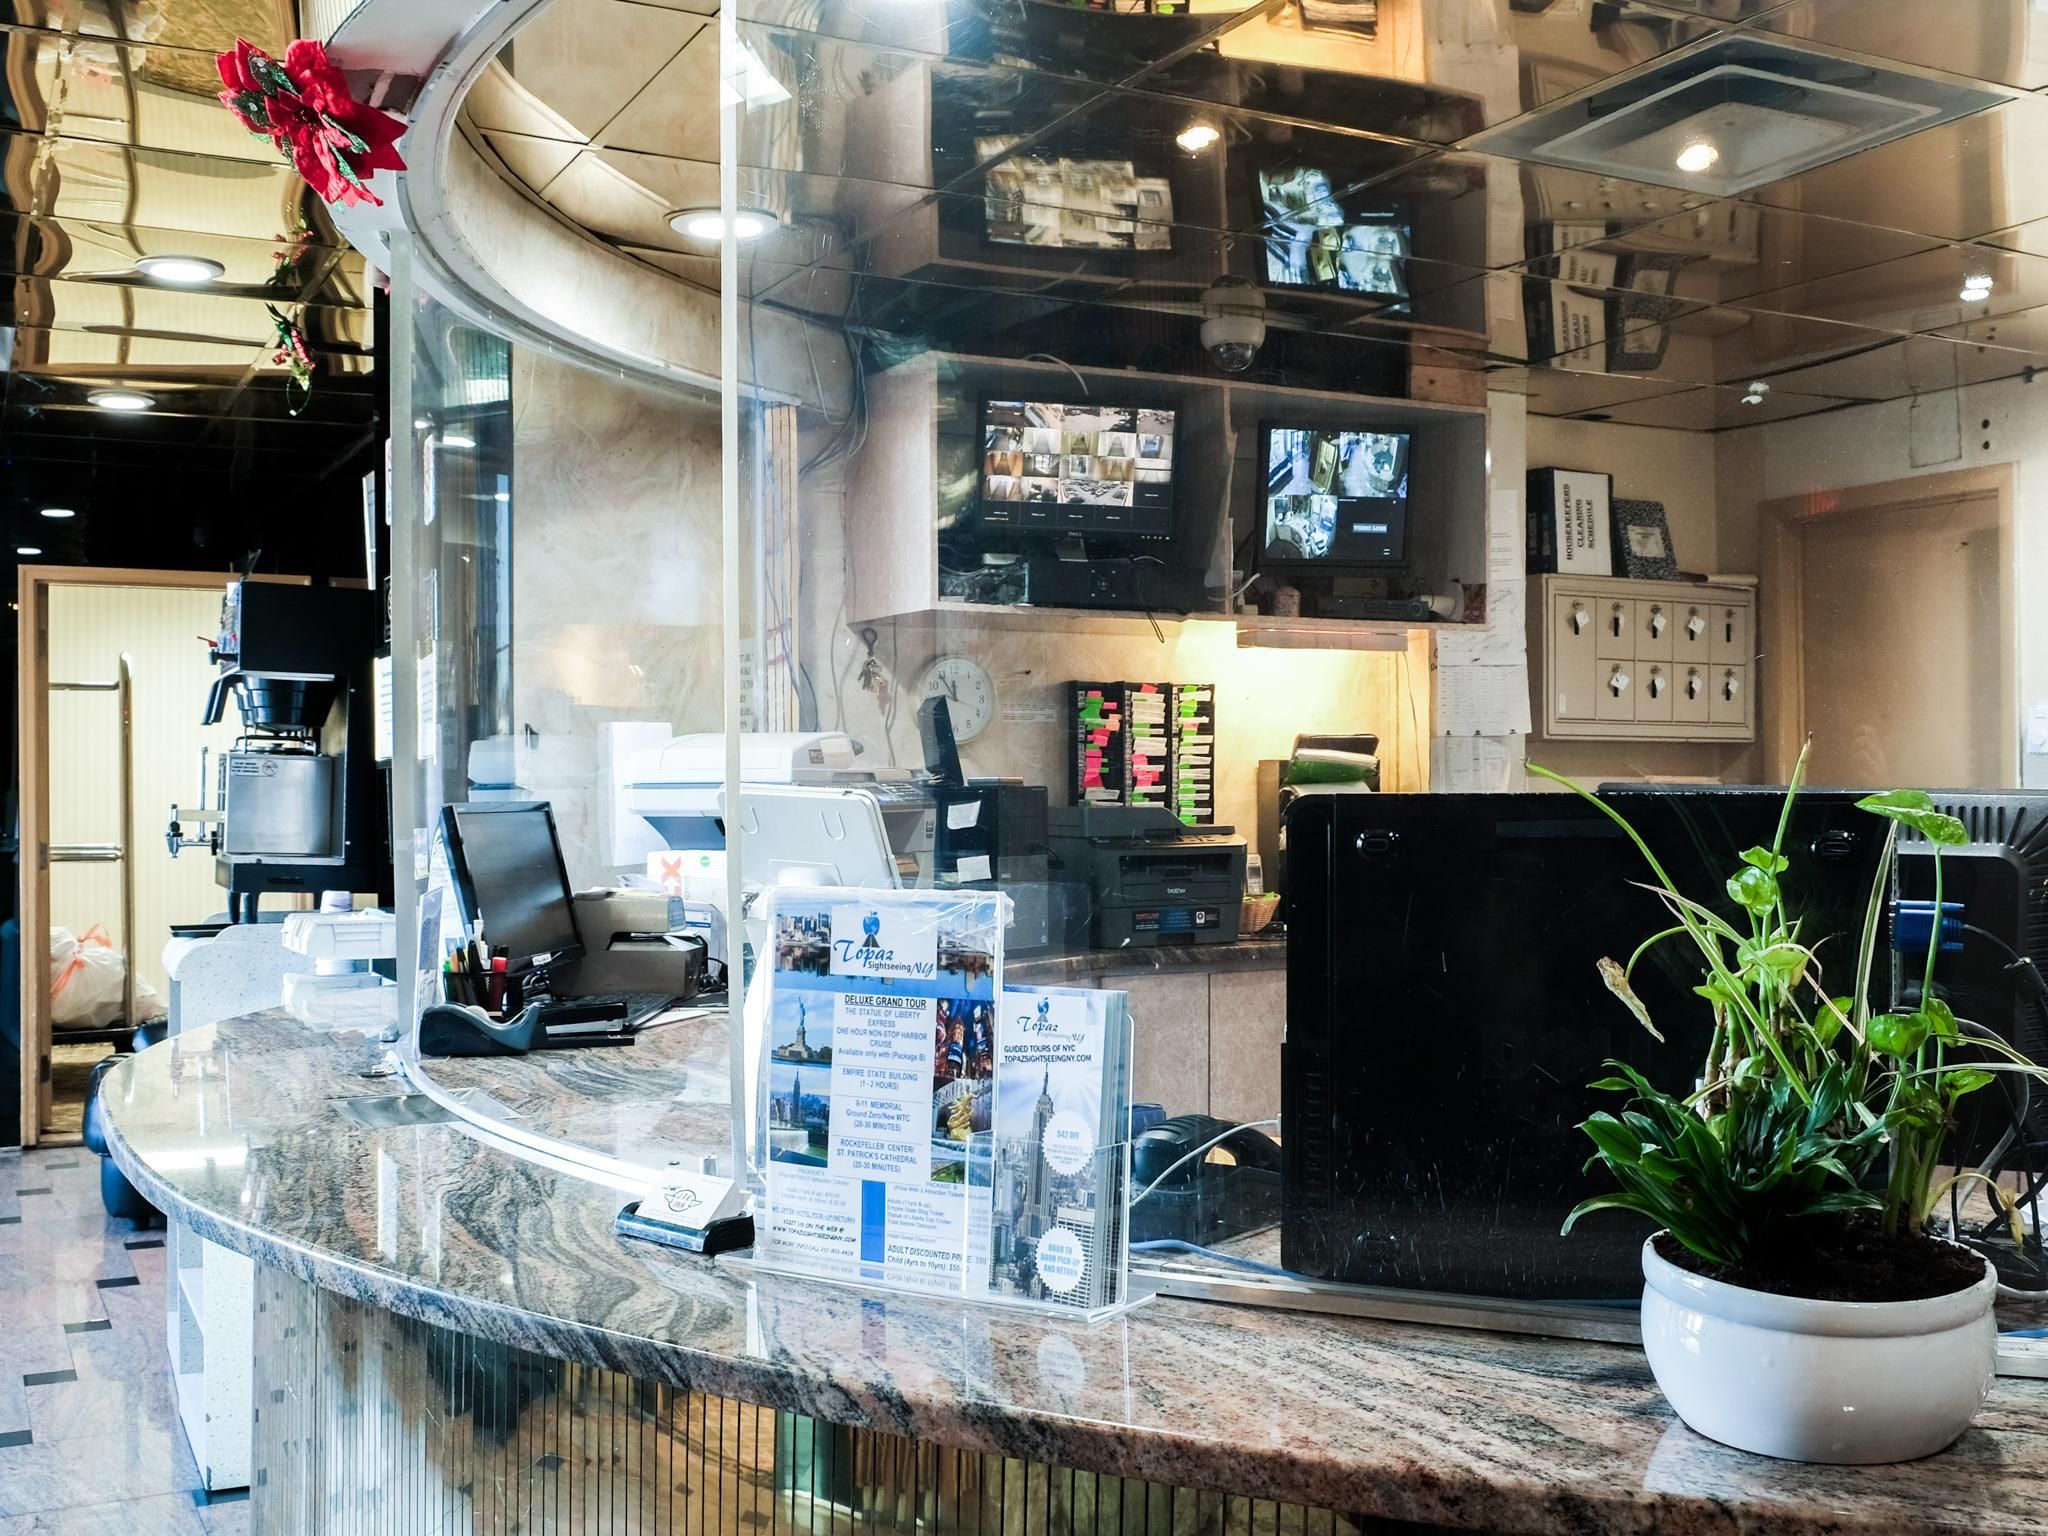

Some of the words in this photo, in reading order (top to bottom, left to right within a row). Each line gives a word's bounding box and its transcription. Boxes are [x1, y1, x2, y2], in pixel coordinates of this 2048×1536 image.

[1563, 483, 1573, 560] HOUSEKEEPERS
[1576, 499, 1585, 548] CLEANING
[1586, 499, 1595, 549] SCHEDULE
[950, 665, 960, 675] 12
[929, 681, 939, 690] 10
[976, 682, 982, 690] 2
[978, 696, 984, 704] 3
[833, 939, 894, 968] Topaz
[868, 961, 912, 974] Sightseeing
[910, 962, 934, 978] NY
[844, 994, 874, 1004] DELUXE
[876, 996, 904, 1006] GRAND
[906, 998, 926, 1008] TOUR
[846, 1007, 856, 1015] THE
[860, 1008, 882, 1016] STATUE
[894, 1010, 920, 1019] LIBERTY
[868, 1019, 896, 1028] EXPRESS
[1016, 1016, 1059, 1036] Topaz
[836, 1026, 848, 1034] ONE
[850, 1028, 867, 1036] HOUR
[869, 1030, 900, 1038] NON-STOP
[902, 1032, 928, 1040] HARBOR
[870, 1040, 892, 1048] CRUISE
[1004, 1044, 1028, 1053] GUIDED
[1030, 1044, 1051, 1052] TOURS
[1052, 1044, 1060, 1052] OF
[1062, 1044, 1076, 1052] NYC
[838, 1048, 864, 1056] Available
[865, 1050, 877, 1059] only
[878, 1050, 890, 1058] with
[892, 1051, 918, 1062] (Package
[1004, 1054, 1092, 1063] TOPAZSIGHTSEEINGNY.COM
[842, 1068, 864, 1076] EMPIRE
[867, 1070, 886, 1078] STATE
[888, 1072, 918, 1081] BUILDING
[876, 1081, 899, 1090] HOURS)
[870, 1101, 902, 1111] MEMORIAL
[846, 1108, 867, 1118] Ground
[868, 1110, 895, 1120] Zero/New
[896, 1114, 910, 1122] WTC
[854, 1120, 872, 1129] (20-30
[872, 1122, 902, 1133] MINUTES)
[840, 1138, 885, 1150] ROCKEFELLER
[848, 1150, 878, 1160] PATRICK'S
[880, 1153, 918, 1164] CATHEDRAL
[852, 1160, 870, 1169] (20-30
[872, 1162, 901, 1173] MINUTES)
[888, 1244, 908, 1255] ADULT
[910, 1248, 950, 1260] DISCOUNTED
[952, 1252, 972, 1264] PRIE
[888, 1255, 903, 1264] Child
[904, 1258, 918, 1268] (4yrs
[920, 1260, 927, 1268] to
[1044, 1263, 1056, 1273] AND
